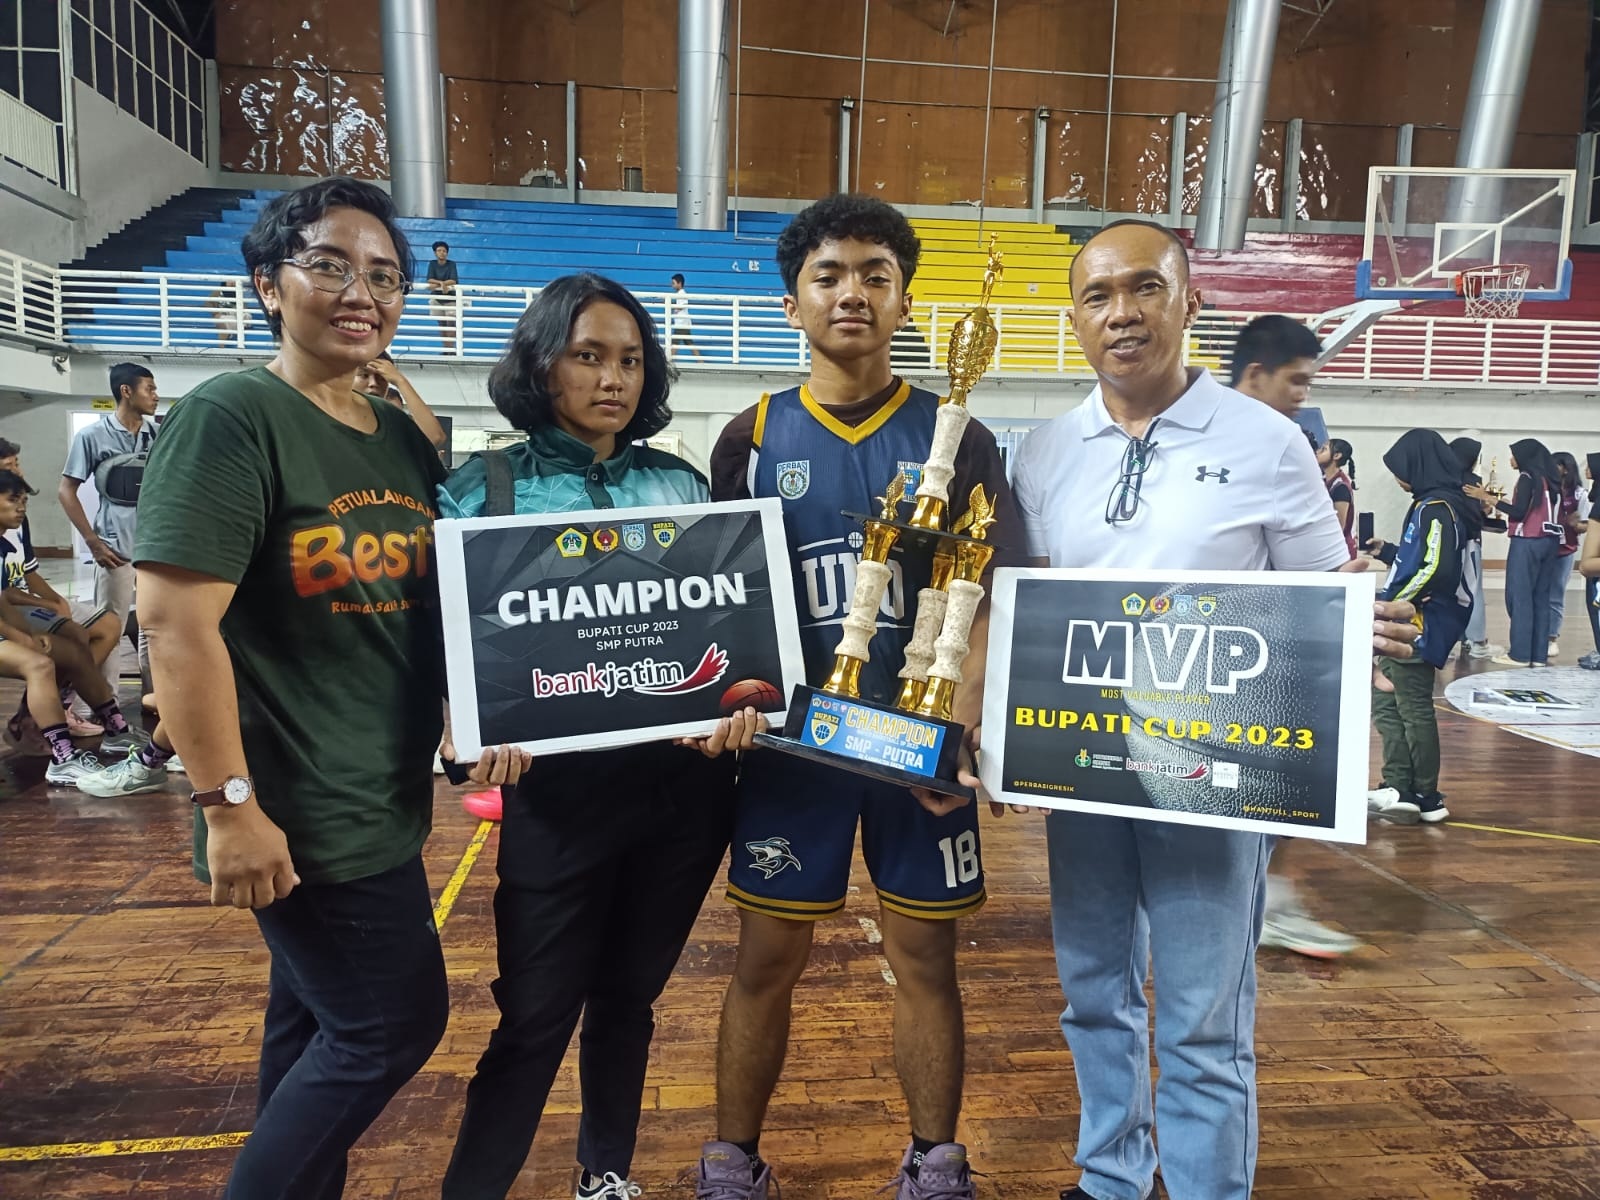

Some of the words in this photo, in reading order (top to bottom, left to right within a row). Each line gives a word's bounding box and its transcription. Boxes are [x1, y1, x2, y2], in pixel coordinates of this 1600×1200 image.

[328, 489, 435, 519] PETUALANGAN
[498, 572, 747, 626] CHAMPION
[577, 625, 623, 639] BUPATI
[625, 623, 650, 635] CUP
[653, 620, 679, 632] 2023
[596, 639, 621, 651] SMP
[624, 636, 664, 649] PUTRA
[1062, 619, 1269, 694] MVP
[532, 658, 685, 698] bankjatim
[1101, 688, 1123, 699] MOST
[1127, 690, 1172, 702] VALUABLE
[1175, 693, 1210, 705] PLAYER
[845, 707, 938, 749] CHAMPION
[1015, 707, 1130, 735] BUPATI
[1143, 717, 1212, 741] CUP
[1226, 723, 1314, 750] 2023
[845, 735, 872, 752] SMP
[882, 745, 924, 769] PUTRA
[1126, 757, 1187, 775] bankjatim
[939, 829, 980, 888] 18
